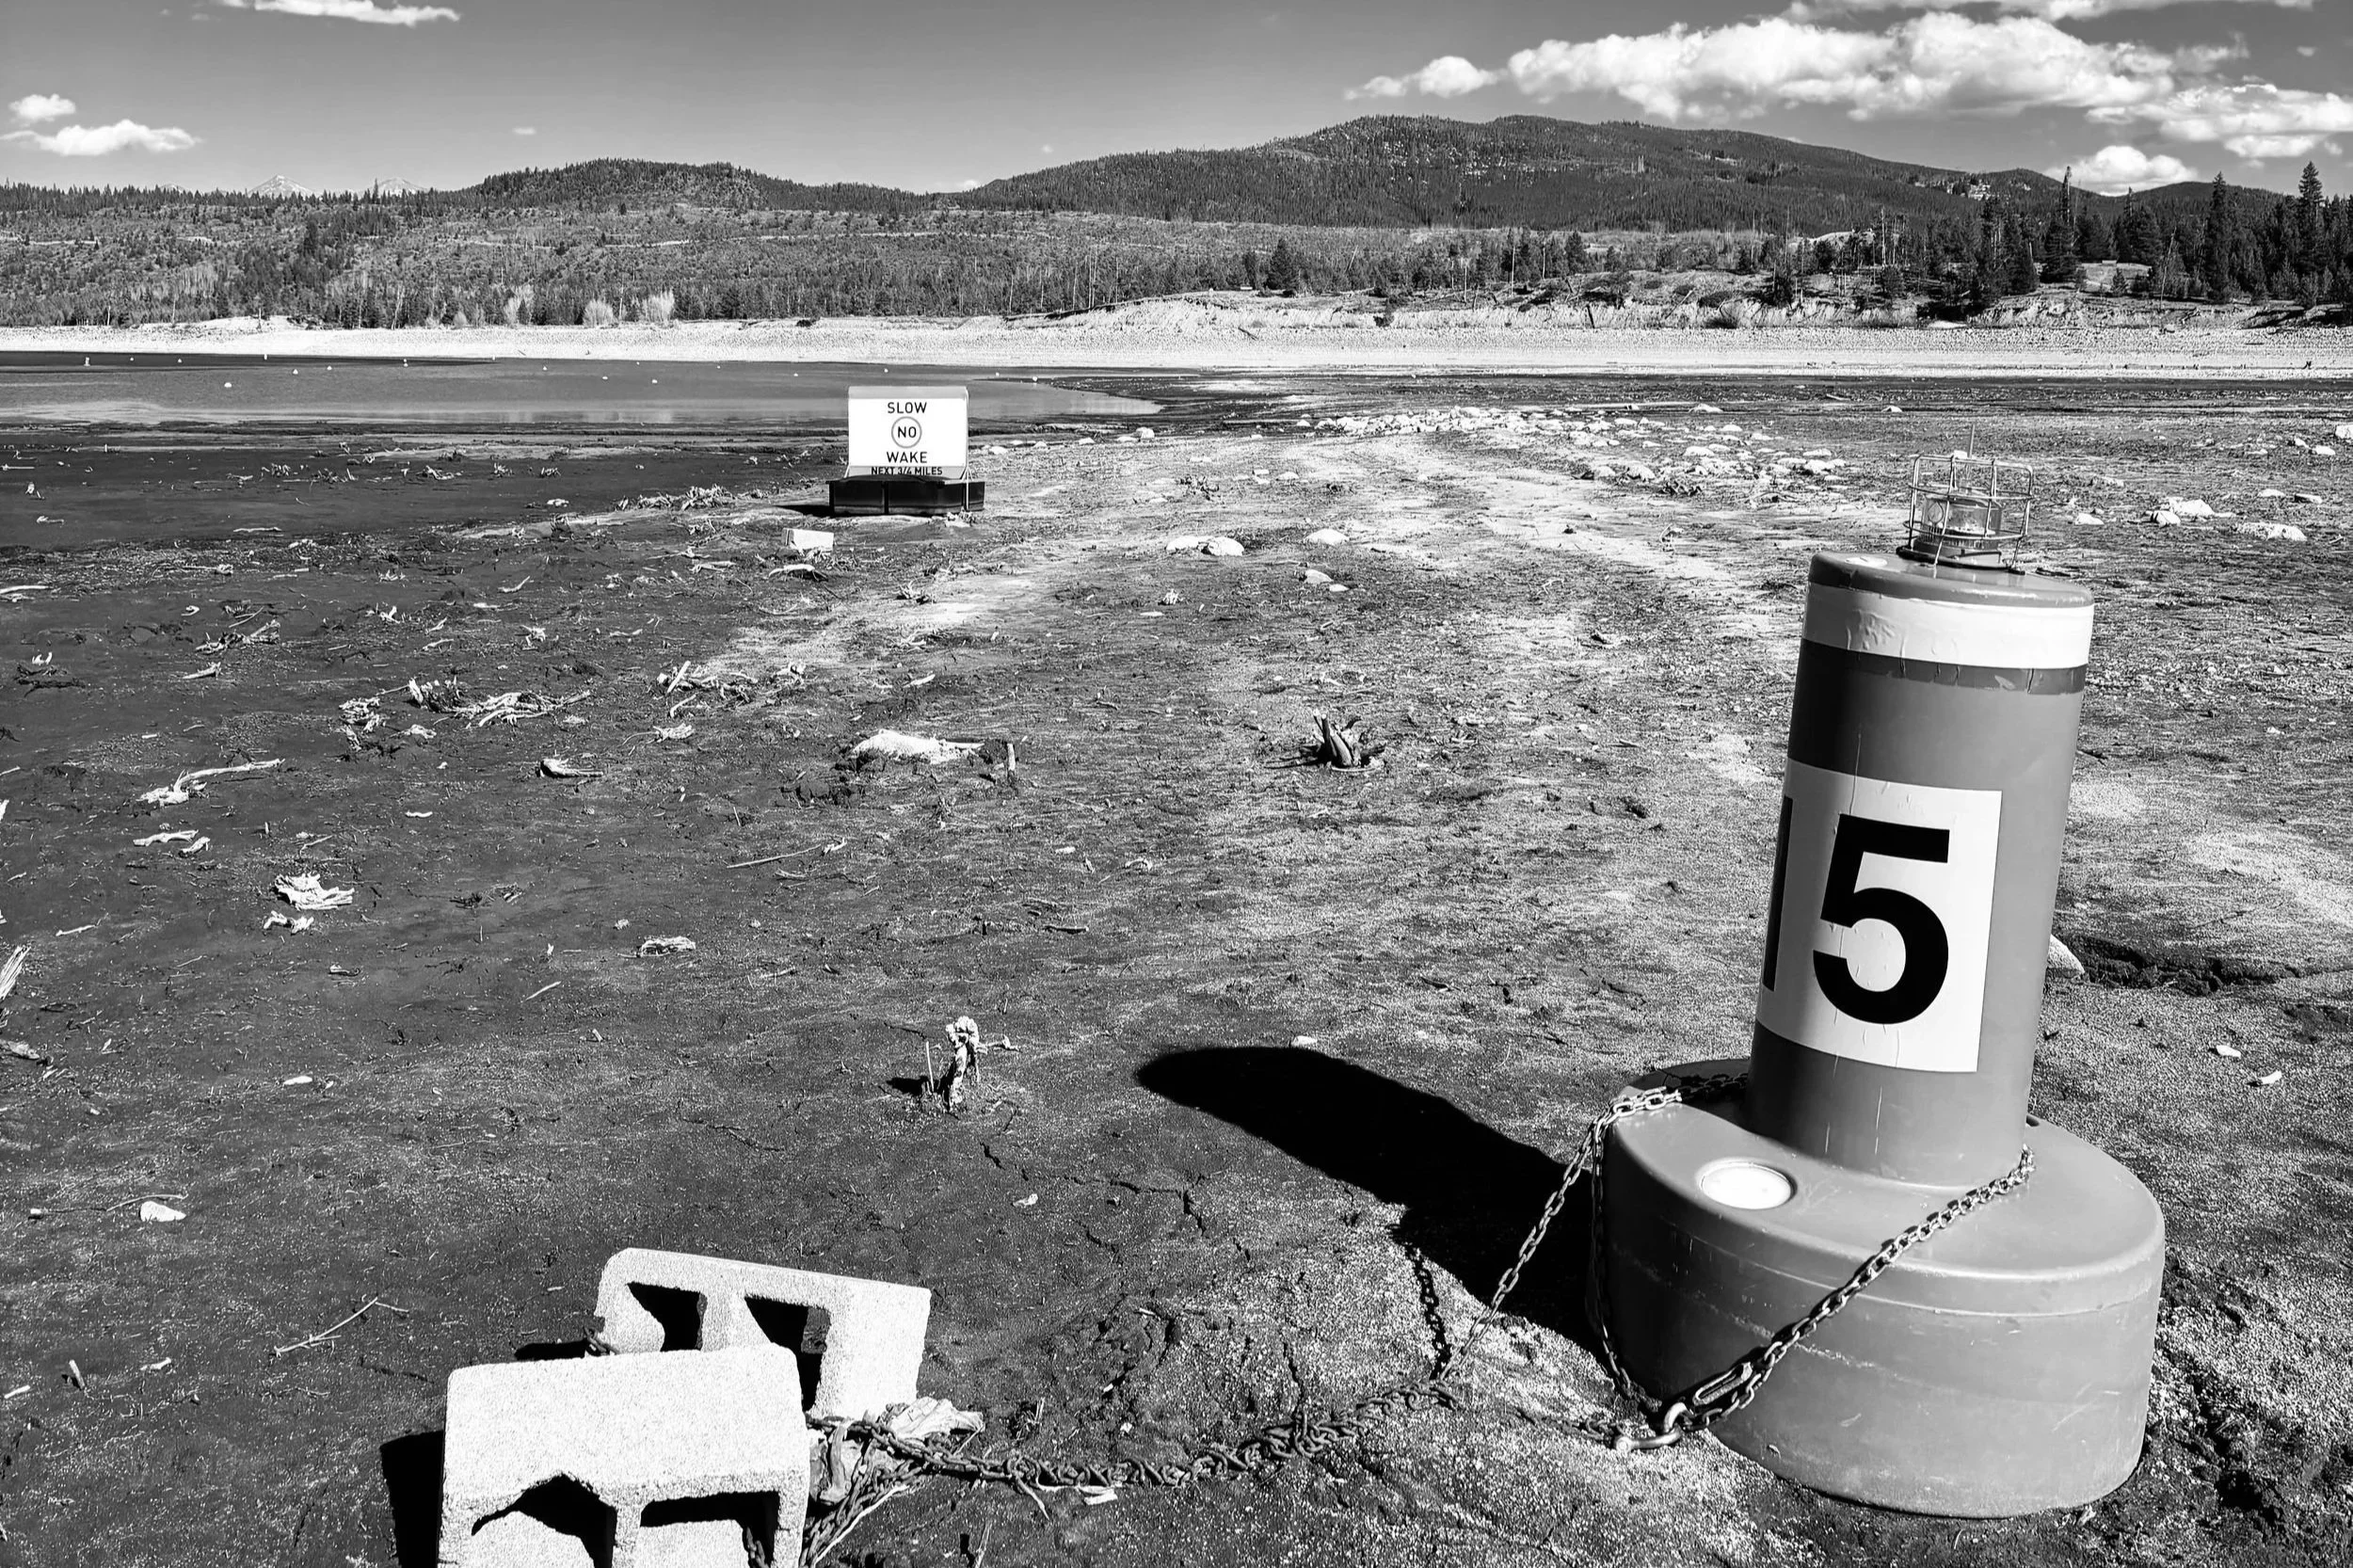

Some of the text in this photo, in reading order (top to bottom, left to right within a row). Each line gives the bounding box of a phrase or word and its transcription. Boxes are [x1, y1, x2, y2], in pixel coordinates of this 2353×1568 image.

[887, 401, 927, 414] SLOW
[897, 425, 917, 439] NO
[886, 451, 928, 464] WAKE
[871, 466, 943, 475] NEXT 3/4 MILES
